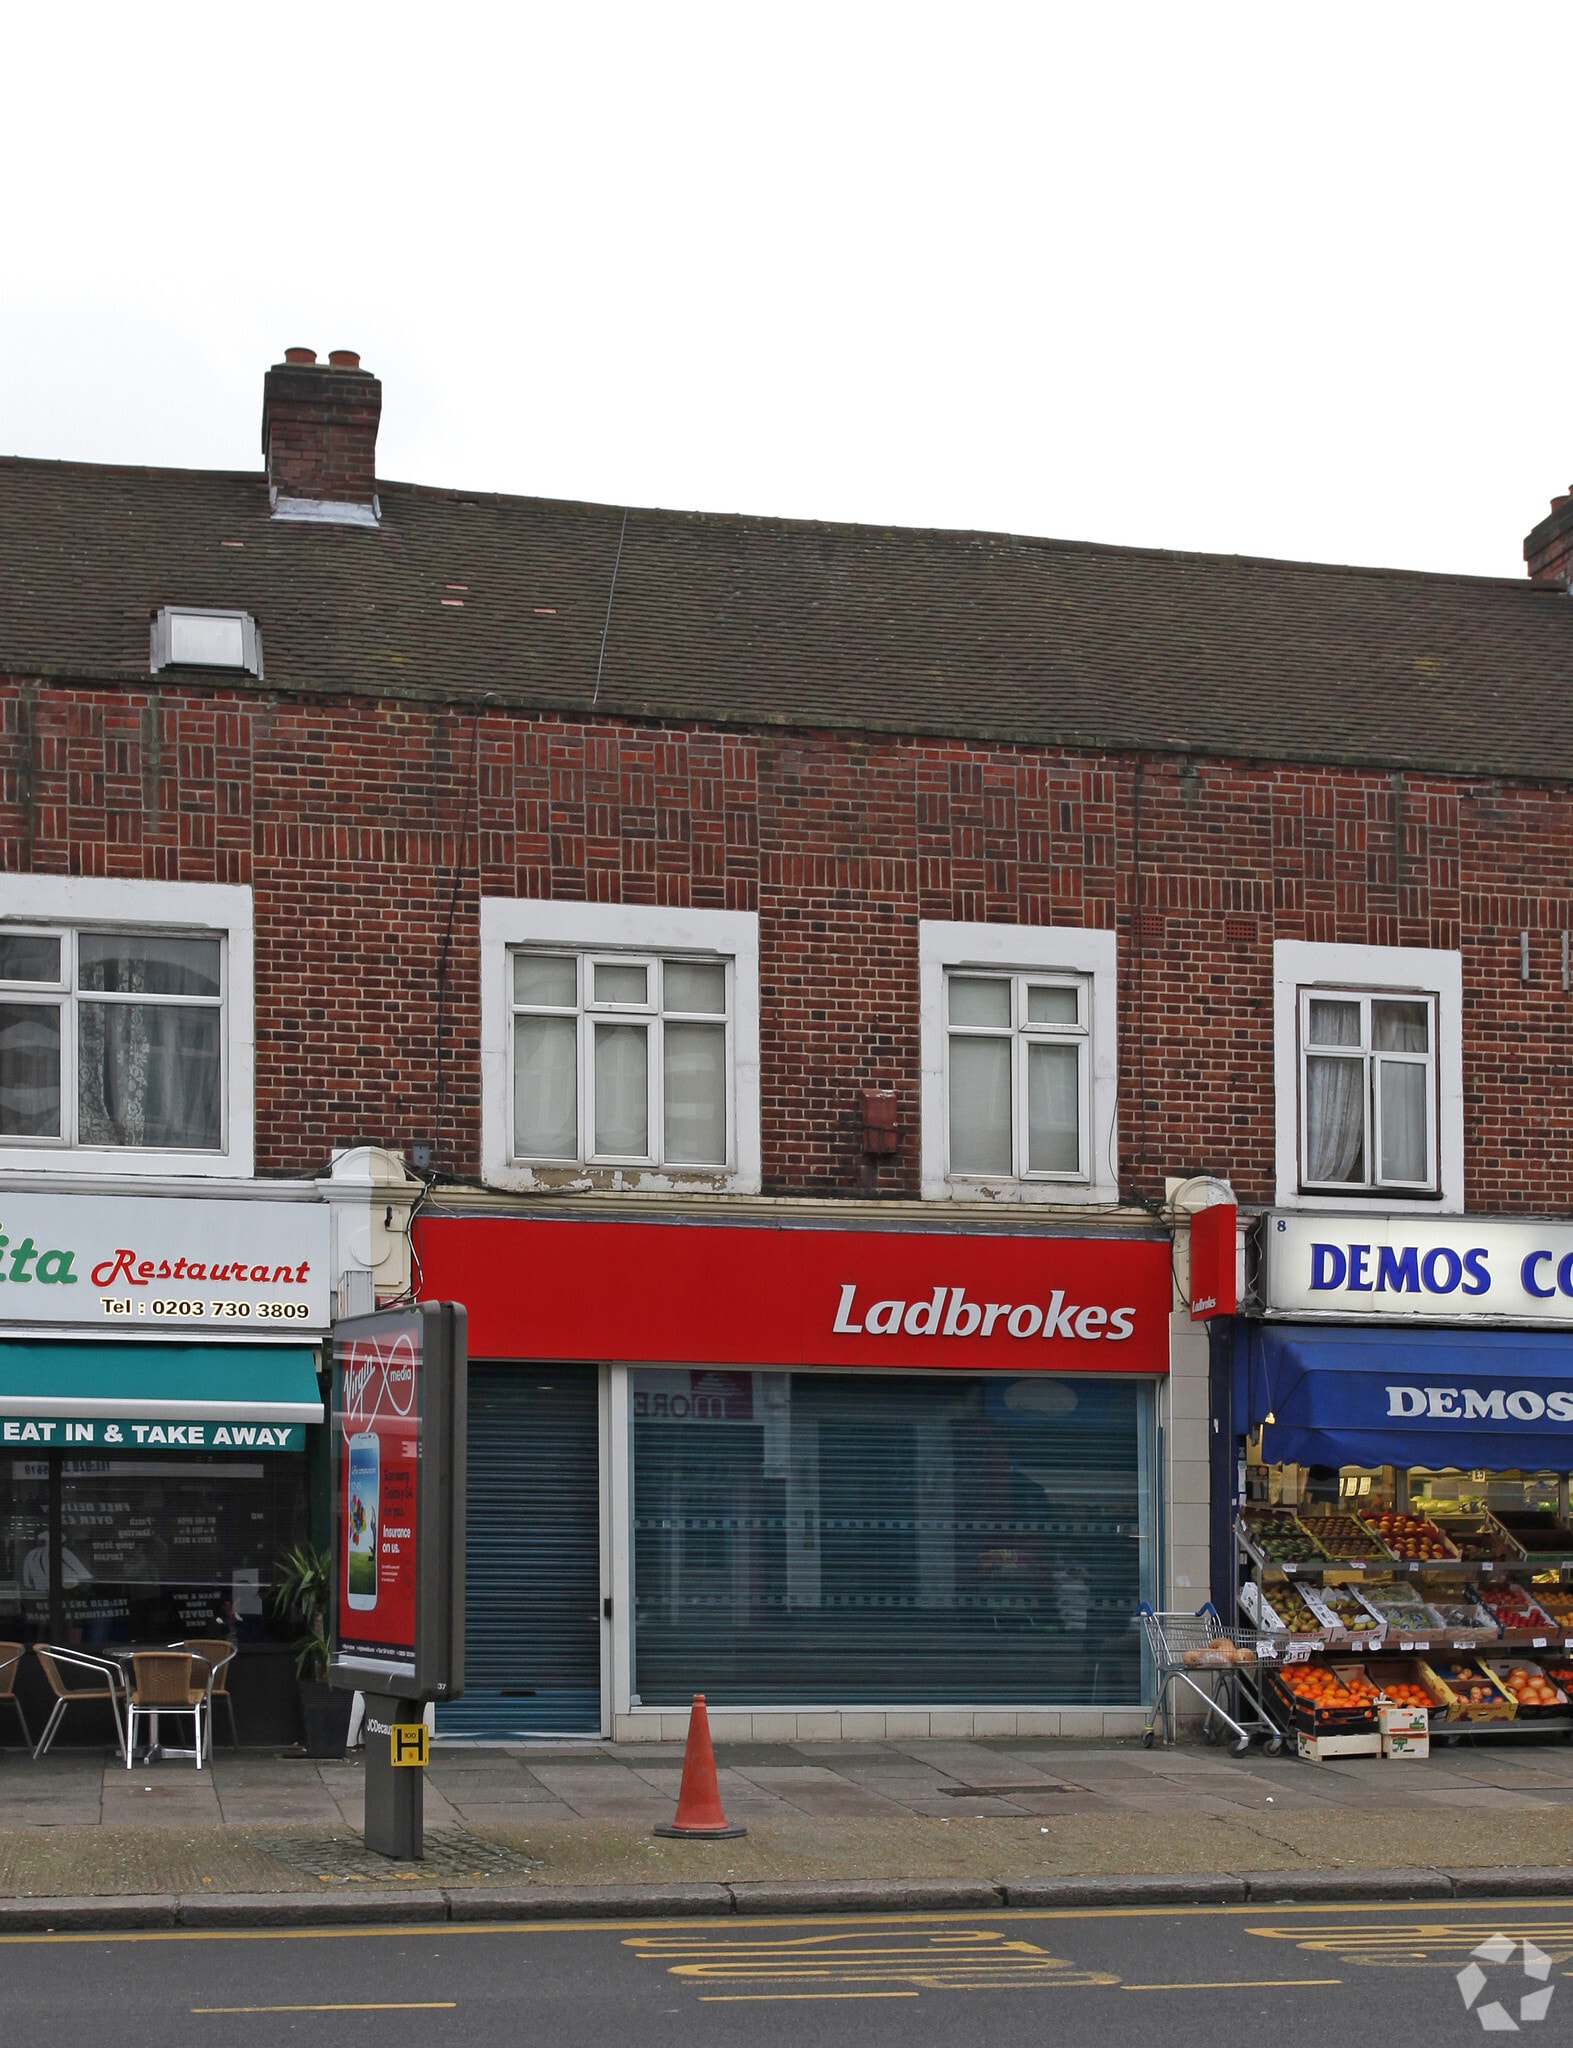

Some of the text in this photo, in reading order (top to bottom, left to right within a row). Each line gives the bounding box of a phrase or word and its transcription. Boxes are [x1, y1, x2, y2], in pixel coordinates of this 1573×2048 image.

[1276, 1219, 1287, 1232] 8
[91, 1249, 311, 1287] Restaurant
[1309, 1243, 1492, 1296] DEMOS
[101, 1299, 131, 1313] Tel
[152, 1301, 204, 1316] 0203
[211, 1303, 250, 1317] 730
[257, 1304, 309, 1319] 3809
[832, 1284, 1136, 1340] Ladbrokes
[343, 1353, 411, 1421] Virgin media
[1385, 1386, 1573, 1422] DEMOS
[3, 1422, 292, 1446] EAT IN & TAKE AWAY
[383, 1524, 411, 1538] Insurance
[382, 1543, 400, 1554] on us.
[367, 1718, 391, 1735] JCDecau
[621, 1930, 1122, 1989] STOP
